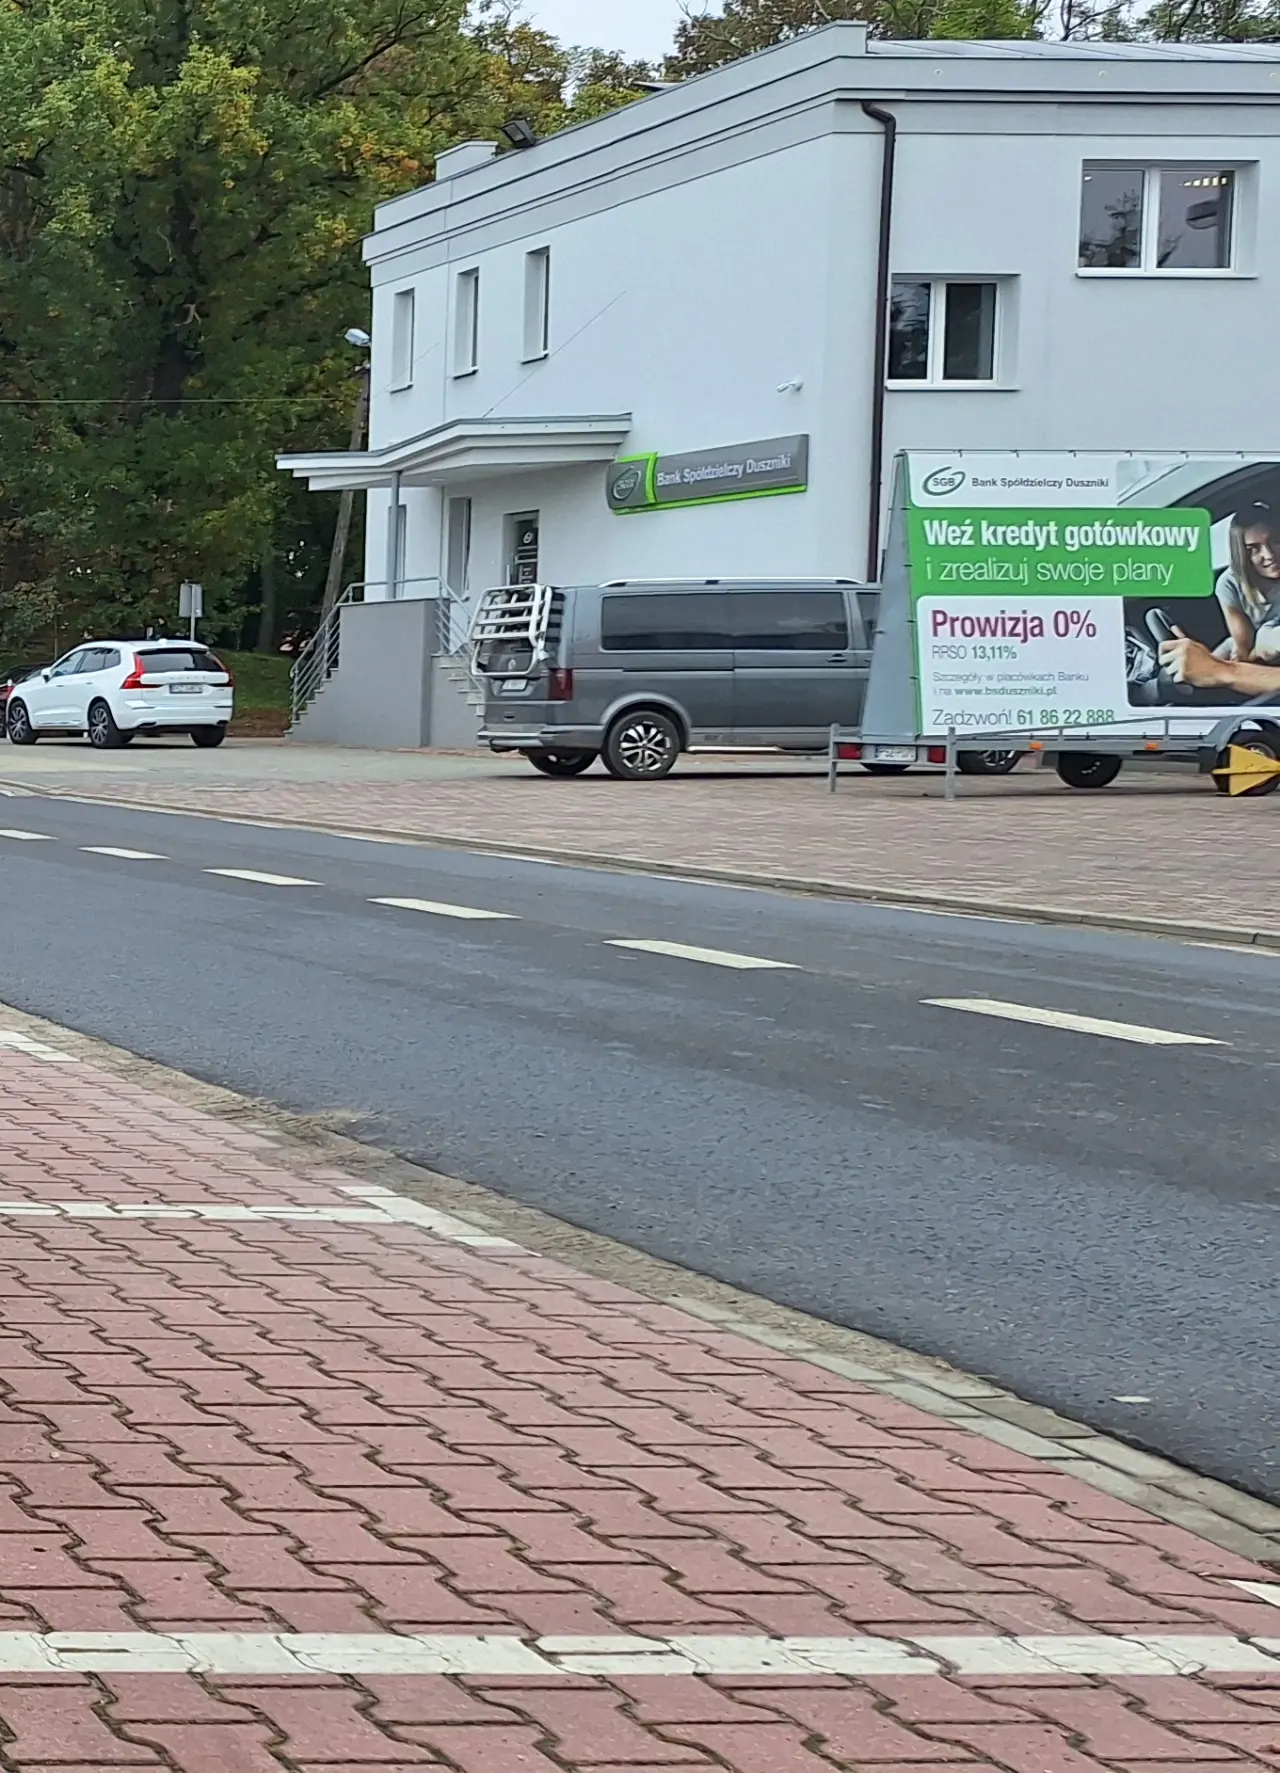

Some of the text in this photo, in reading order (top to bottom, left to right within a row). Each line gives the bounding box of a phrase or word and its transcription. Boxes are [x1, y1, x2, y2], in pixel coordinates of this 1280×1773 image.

[656, 453, 792, 487] Bank Spółdzielczy Duszniki
[932, 477, 955, 487] SGB
[971, 477, 1109, 489] Bank Spółdzielczy Duszniki
[923, 518, 1200, 552] Weź kredyt gotówkowy
[925, 556, 1174, 586] i zrealizuj swoje plany
[931, 609, 1097, 644] Prowizja 0%
[931, 645, 1017, 662] RRSO 13,11%
[932, 671, 1089, 684] Szczegóły w placówkach Banku
[939, 687, 952, 696] na
[954, 686, 1057, 697] www.bsduszniki.pl
[931, 708, 1115, 726] Zadzwoń! 61 86 22 888
